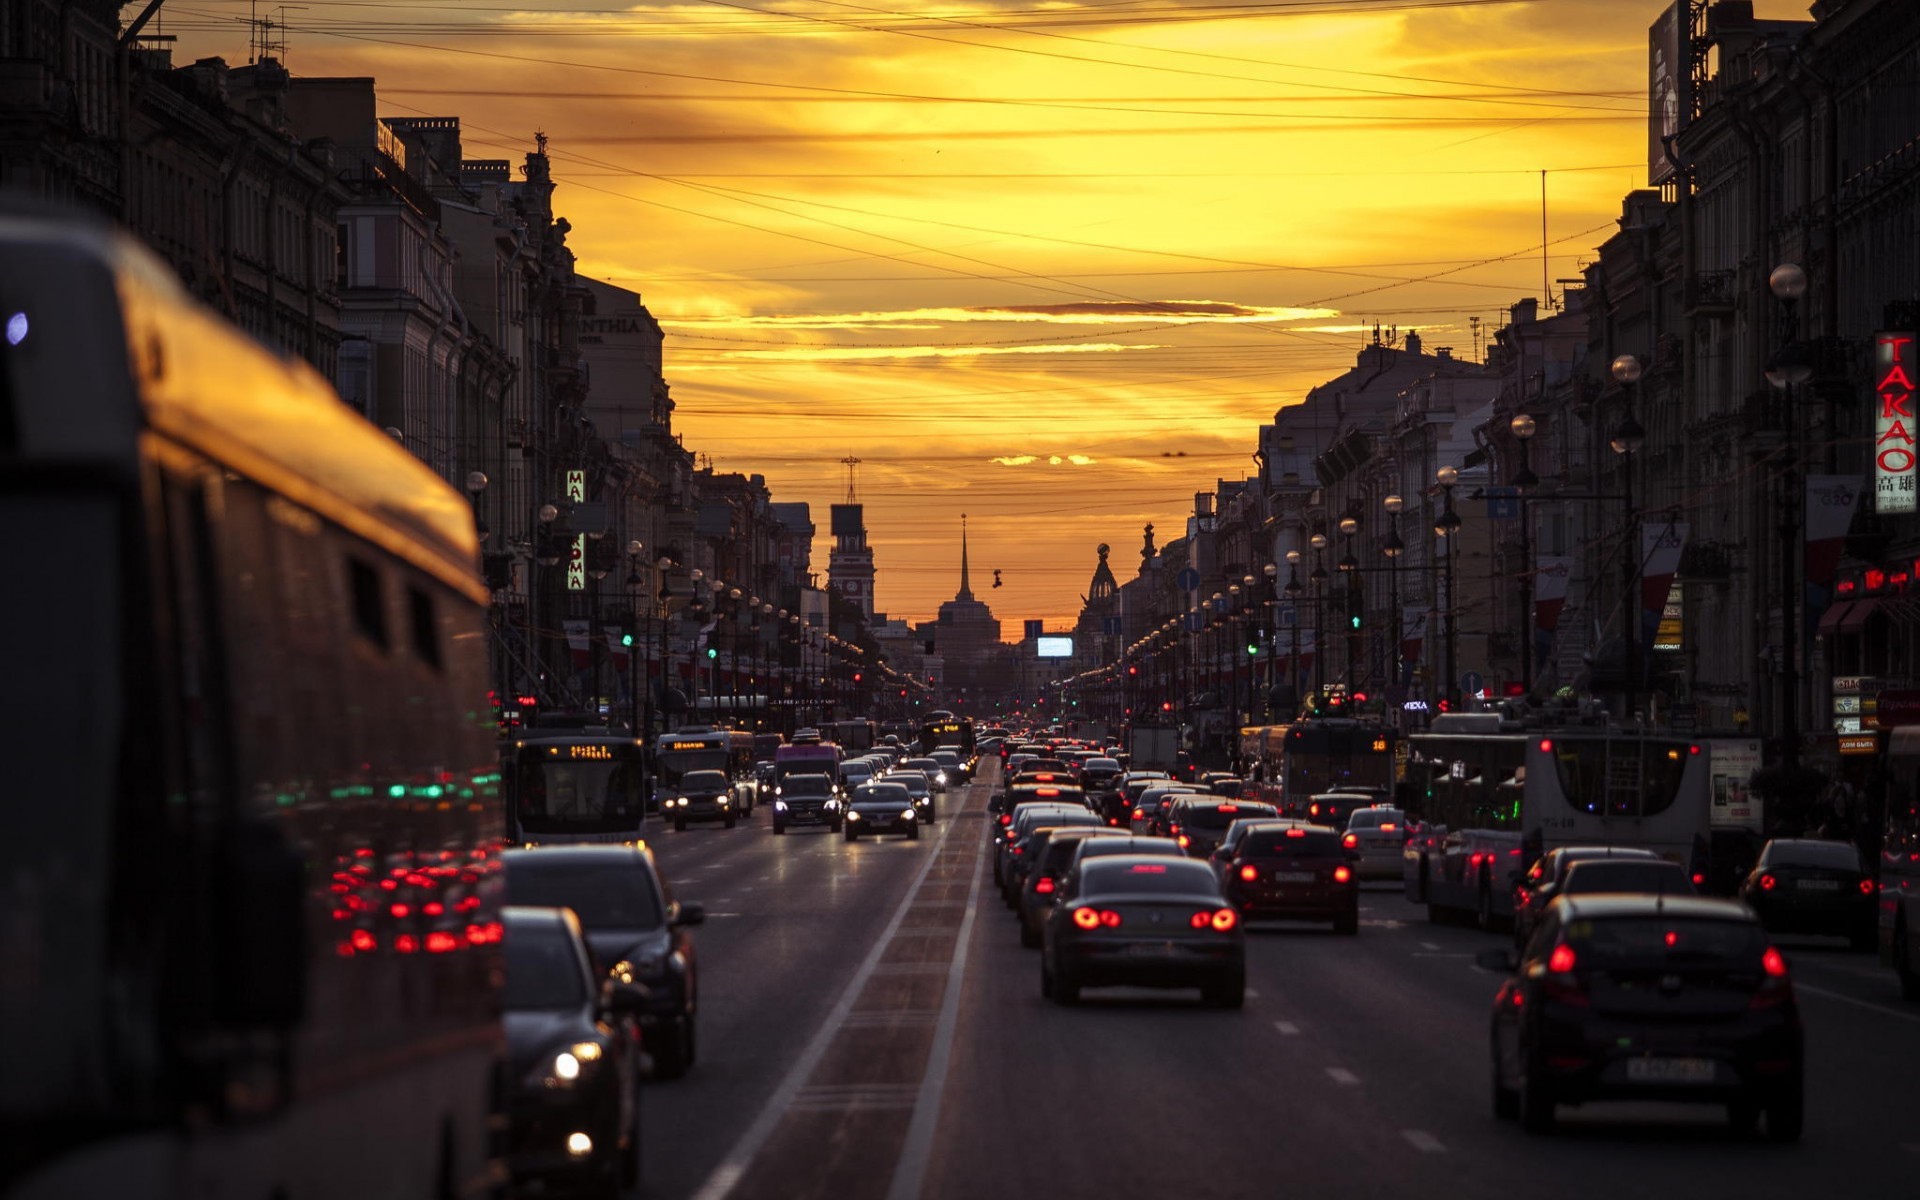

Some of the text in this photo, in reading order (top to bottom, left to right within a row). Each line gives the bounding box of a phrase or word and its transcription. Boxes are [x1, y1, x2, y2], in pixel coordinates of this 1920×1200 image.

[581, 319, 641, 333] NTHIA
[1876, 337, 1916, 472] TAKAO
[1878, 476, 1914, 492] 高雄
